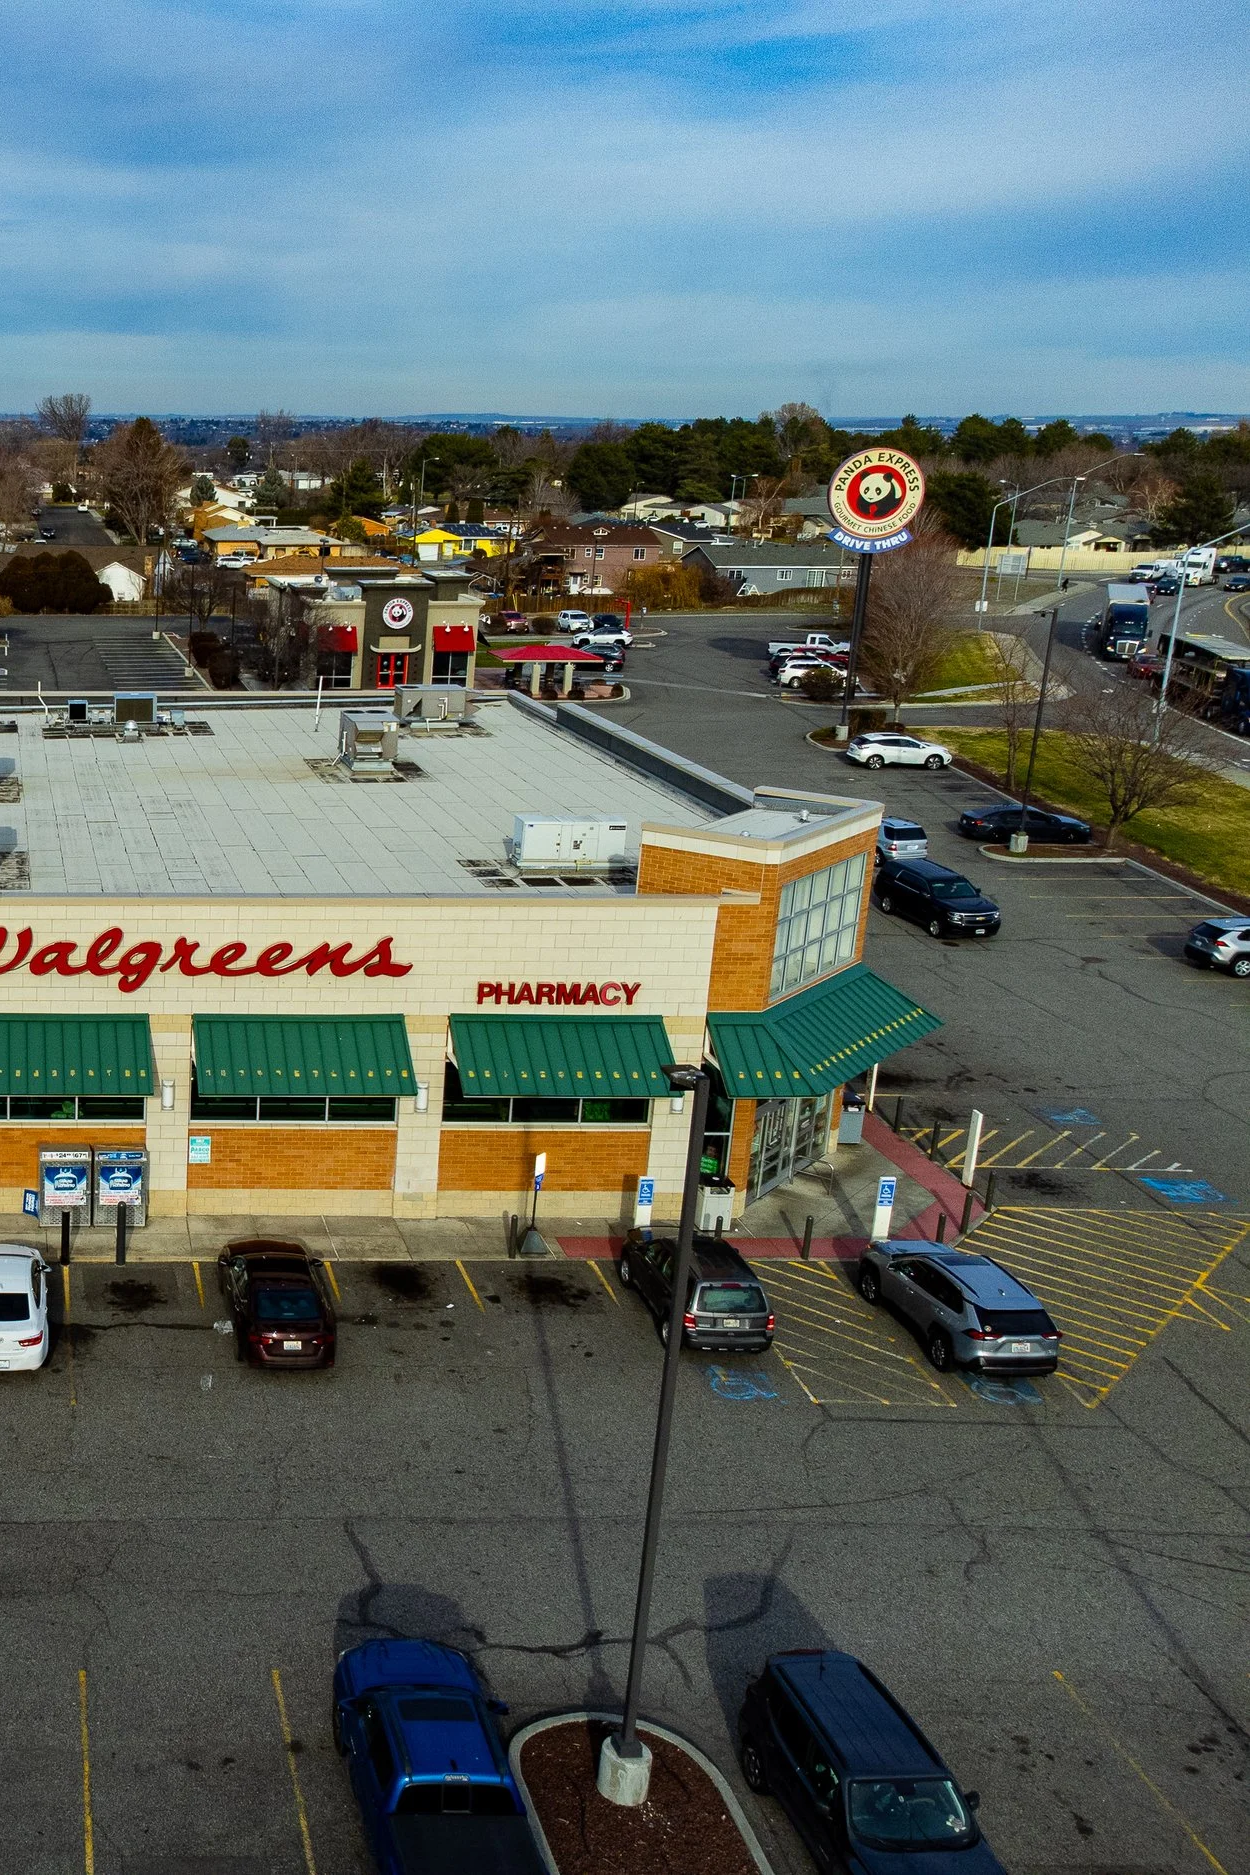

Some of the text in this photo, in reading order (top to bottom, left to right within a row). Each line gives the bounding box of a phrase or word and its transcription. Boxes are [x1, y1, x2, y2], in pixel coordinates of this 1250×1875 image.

[835, 452, 919, 492] PANDA EXPRESS
[834, 502, 916, 534] GOURMET CHINESE FOOD
[834, 531, 908, 551] DRIVE THRU
[477, 981, 641, 1006] PHARMACY
